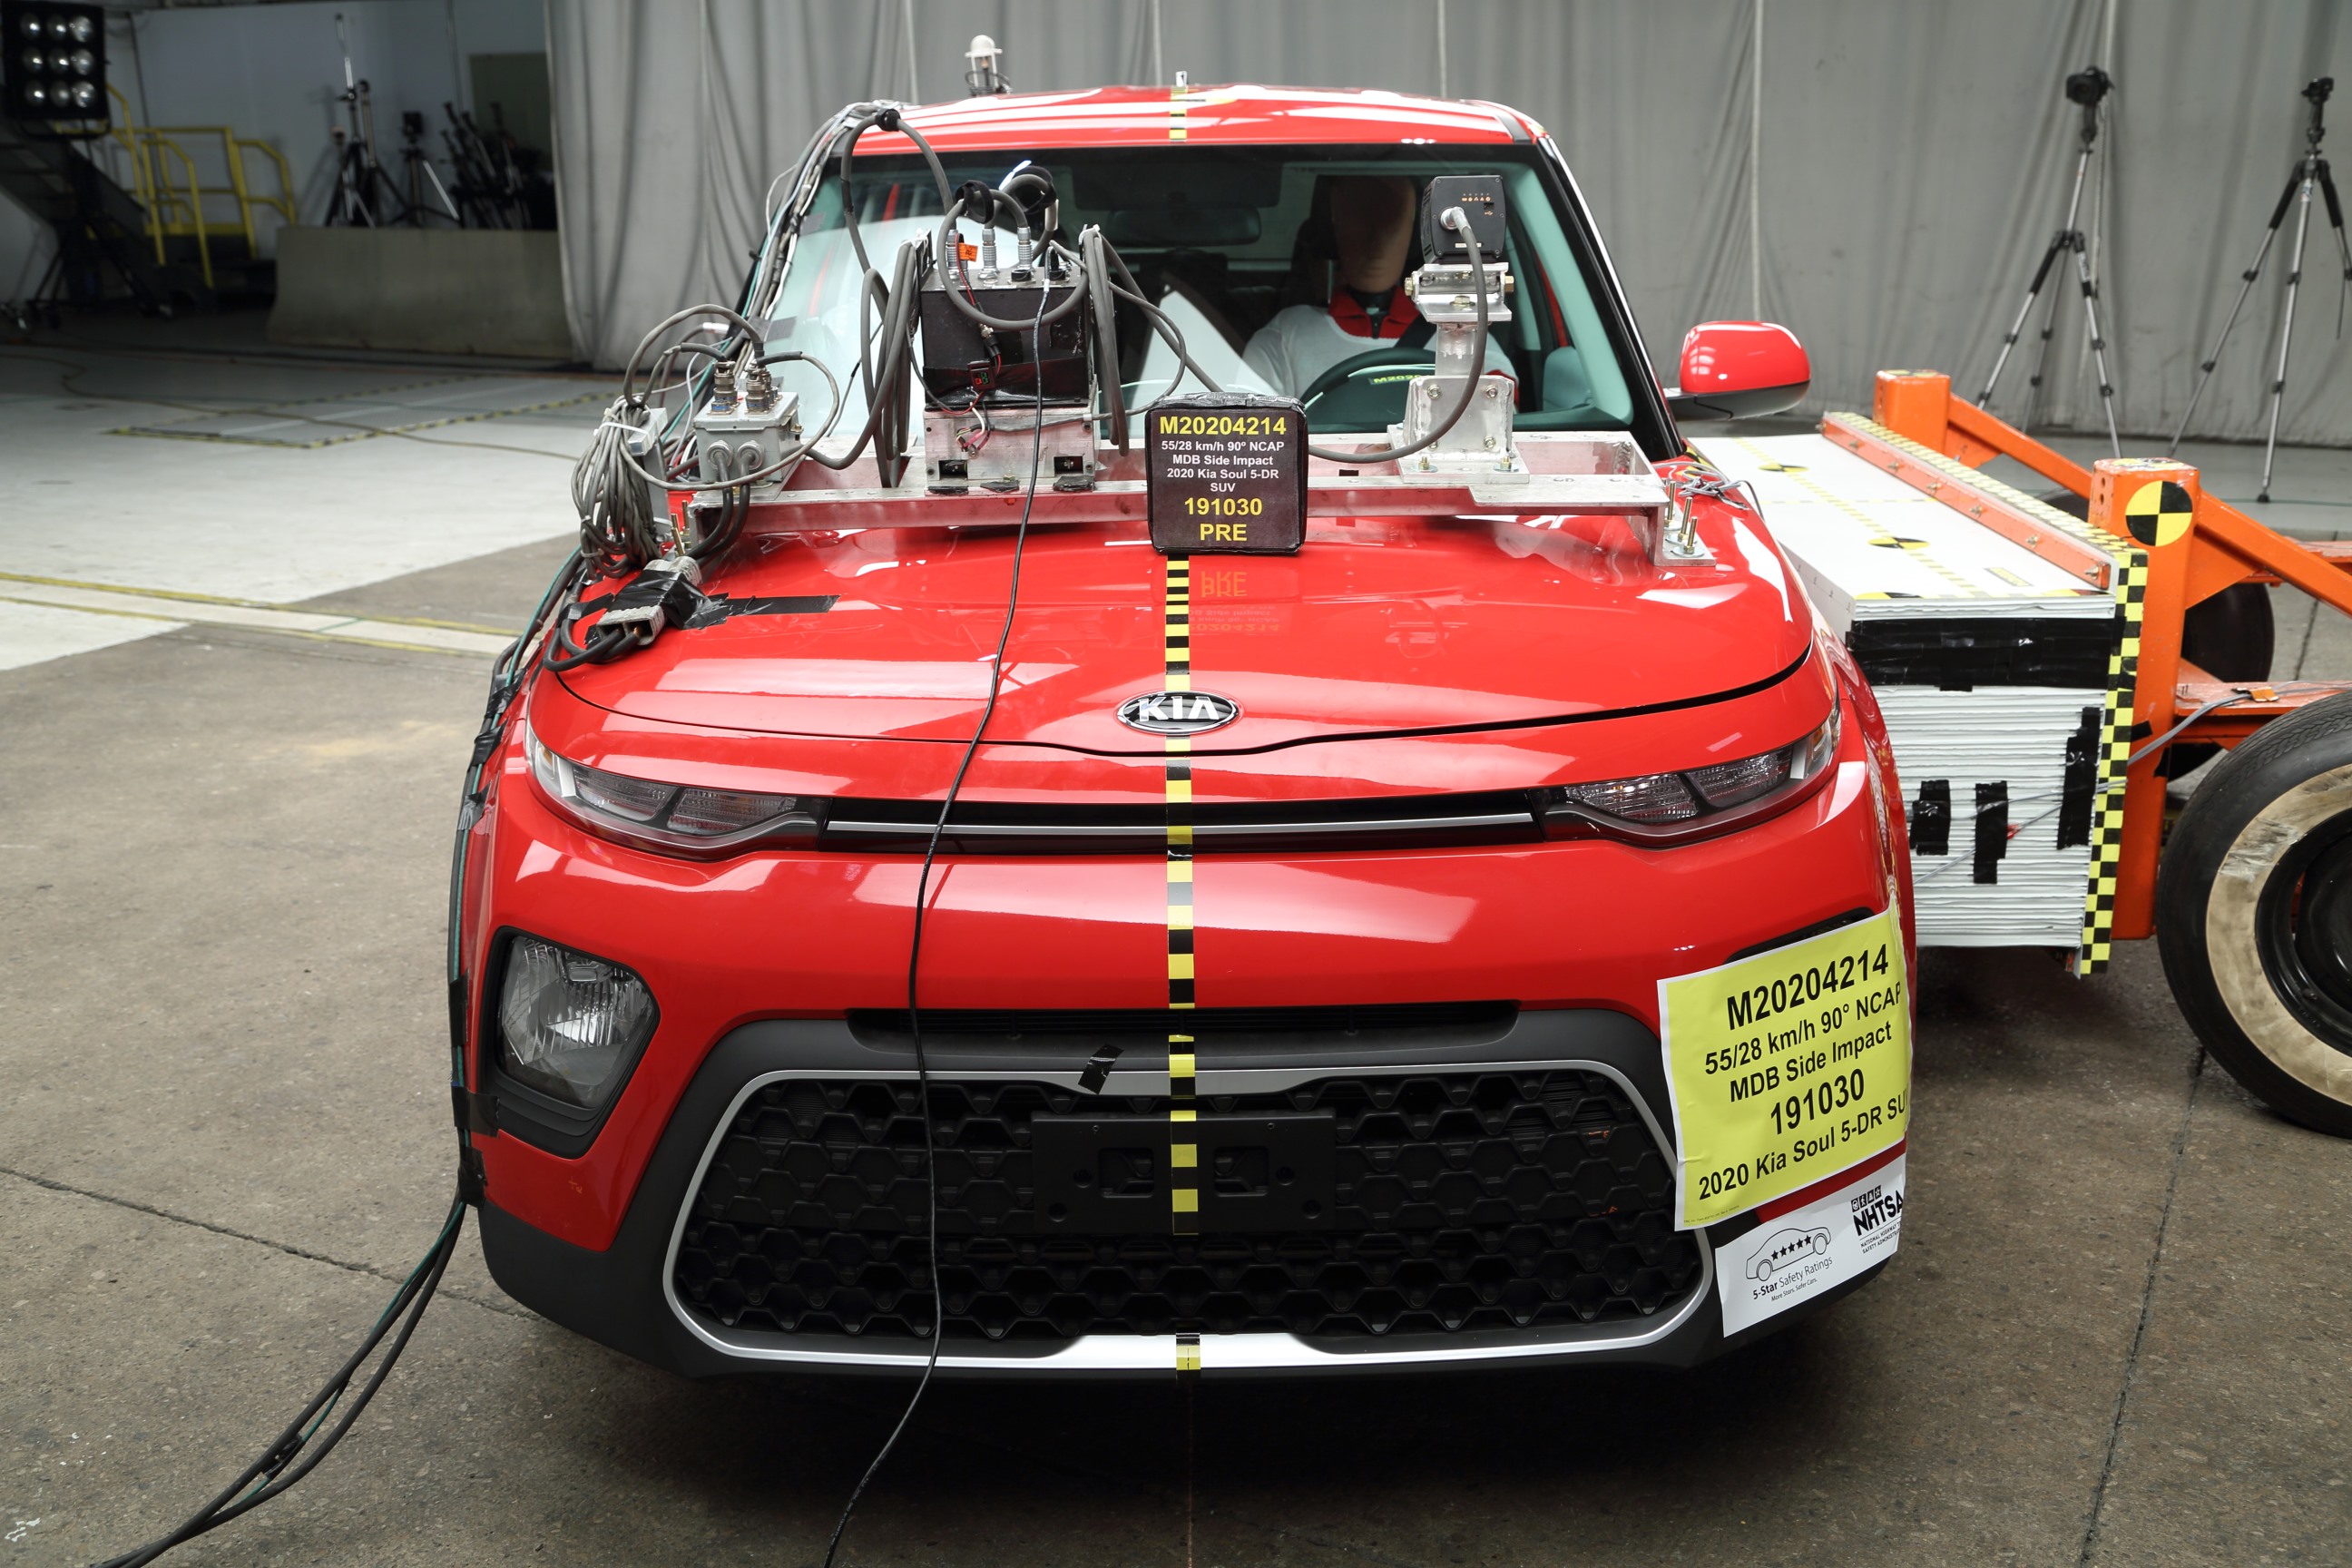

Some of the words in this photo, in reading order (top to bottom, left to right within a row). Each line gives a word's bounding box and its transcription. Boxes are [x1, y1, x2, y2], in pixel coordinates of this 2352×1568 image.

[1160, 416, 1287, 436] M20204214
[1161, 440, 1192, 451] 55/28
[1195, 441, 1224, 452] km/h
[1249, 441, 1285, 452] NCAP
[1172, 454, 1200, 465] MDB
[1203, 455, 1230, 466] Side
[1233, 455, 1274, 467] Impact
[1166, 467, 1194, 478] 2020
[1197, 468, 1217, 479] Kia
[1220, 468, 1247, 479] Soul
[1250, 468, 1279, 479] 5-DR
[1210, 482, 1236, 493] SUV
[1184, 497, 1263, 516] 191030
[1200, 523, 1248, 542] PRE
[1138, 696, 1220, 721] KIA
[1727, 943, 1888, 1031] M20204214
[1705, 1037, 1762, 1075] 55/28
[1768, 1019, 1816, 1054] km/h
[1856, 981, 1901, 1021] NCAP
[1730, 1065, 1780, 1102] MDB
[1786, 1050, 1827, 1082] Side
[1832, 1021, 1892, 1063] Impact
[1770, 1068, 1865, 1135] 191030
[1699, 1162, 1749, 1200] 2020
[1756, 1152, 1787, 1180] Kia
[1793, 1126, 1835, 1162] Soul
[1841, 1105, 1883, 1142] 5-DR
[1853, 1190, 1904, 1237] NHTSA
[1752, 1282, 1779, 1300] 5-Star
[1779, 1271, 1803, 1288] Safety
[1804, 1257, 1833, 1276] Ratings
[1771, 1293, 1783, 1301] More
